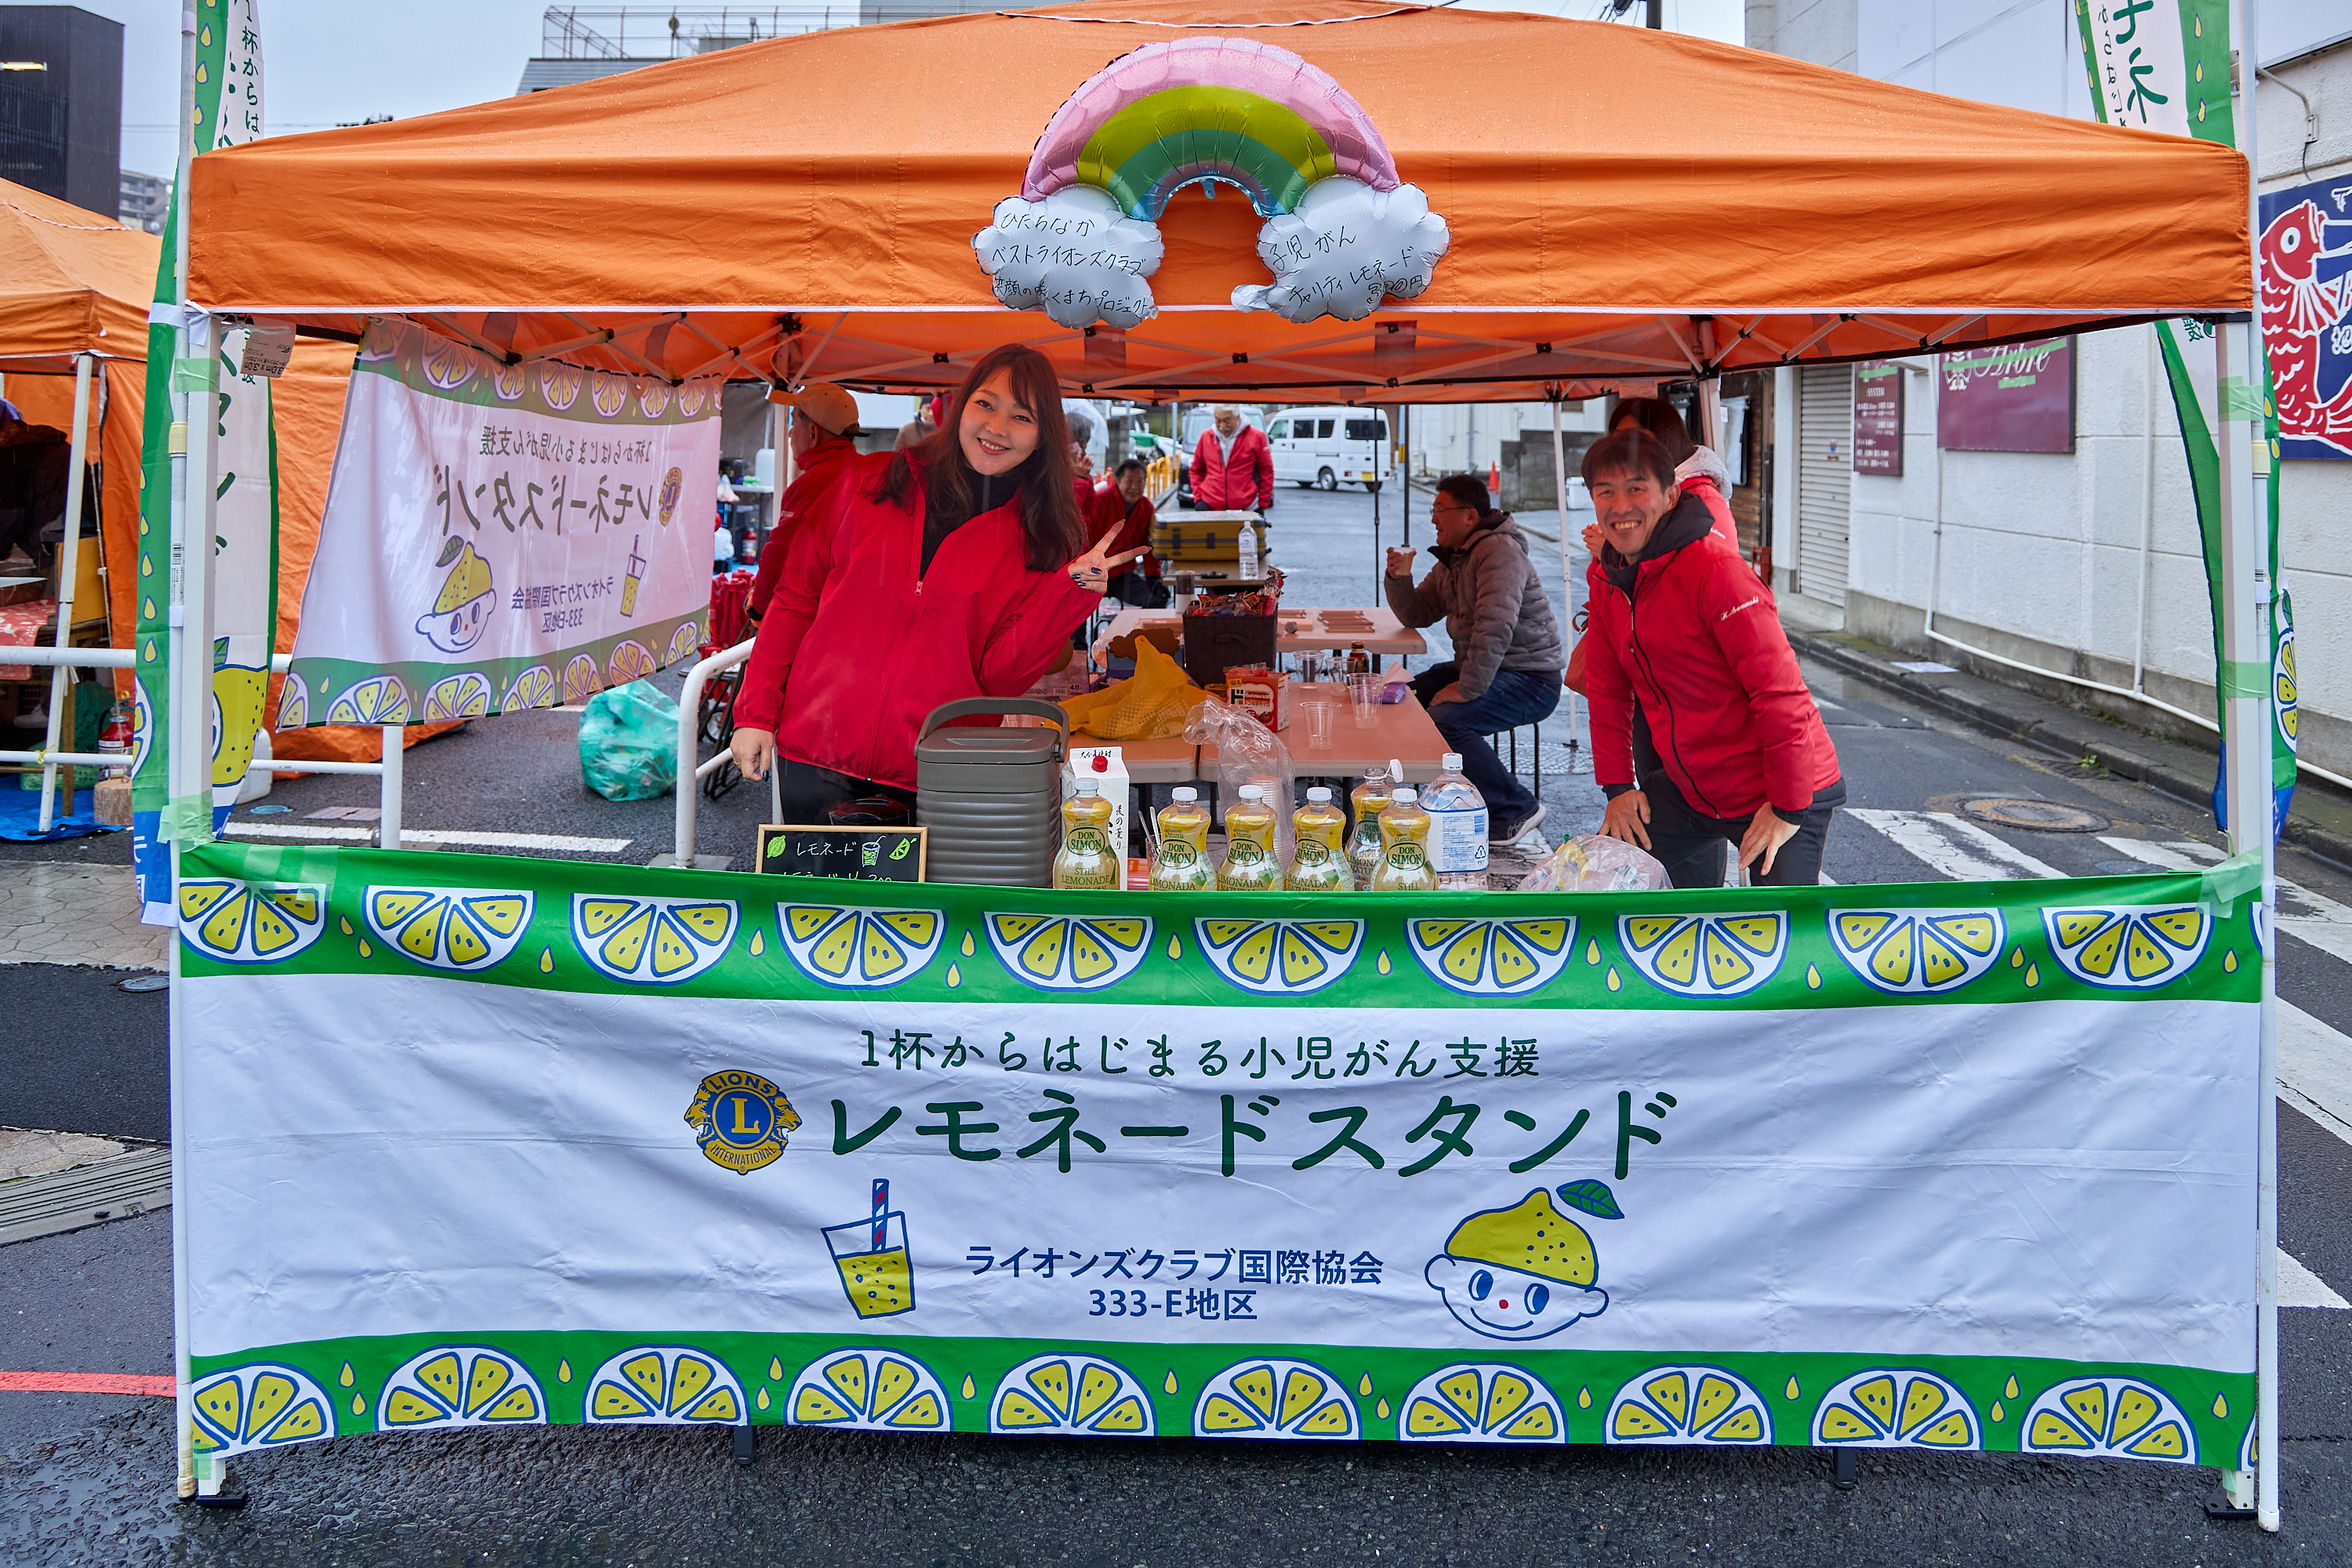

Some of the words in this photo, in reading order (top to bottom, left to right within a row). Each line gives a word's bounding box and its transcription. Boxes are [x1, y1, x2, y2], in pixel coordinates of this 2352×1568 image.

[992, 244, 1146, 276] ベストライオンズクラブ
[1078, 831, 1095, 840] DON
[797, 841, 857, 856] レモネード
[1070, 840, 1102, 851] SIMON
[1168, 844, 1185, 852] DON
[1236, 842, 1252, 851] DON
[1161, 851, 1192, 863] SIMON
[1229, 848, 1259, 861] SIMON
[1391, 854, 1421, 865] SIMON
[1074, 867, 1097, 876] STILL
[1062, 874, 1110, 886] LEMONADE
[1398, 882, 1421, 891] STILL
[862, 1029, 1541, 1078] 1杯からはじまる小児がん支援
[708, 1073, 773, 1095] LIONS
[731, 1098, 760, 1134] L
[829, 1087, 1678, 1180] レモネードスタンド
[710, 1144, 777, 1166] INTERNATIONAL
[965, 1246, 1385, 1287] ライオンズクラブ国際協会
[1088, 1288, 1258, 1322] 333-E地区
